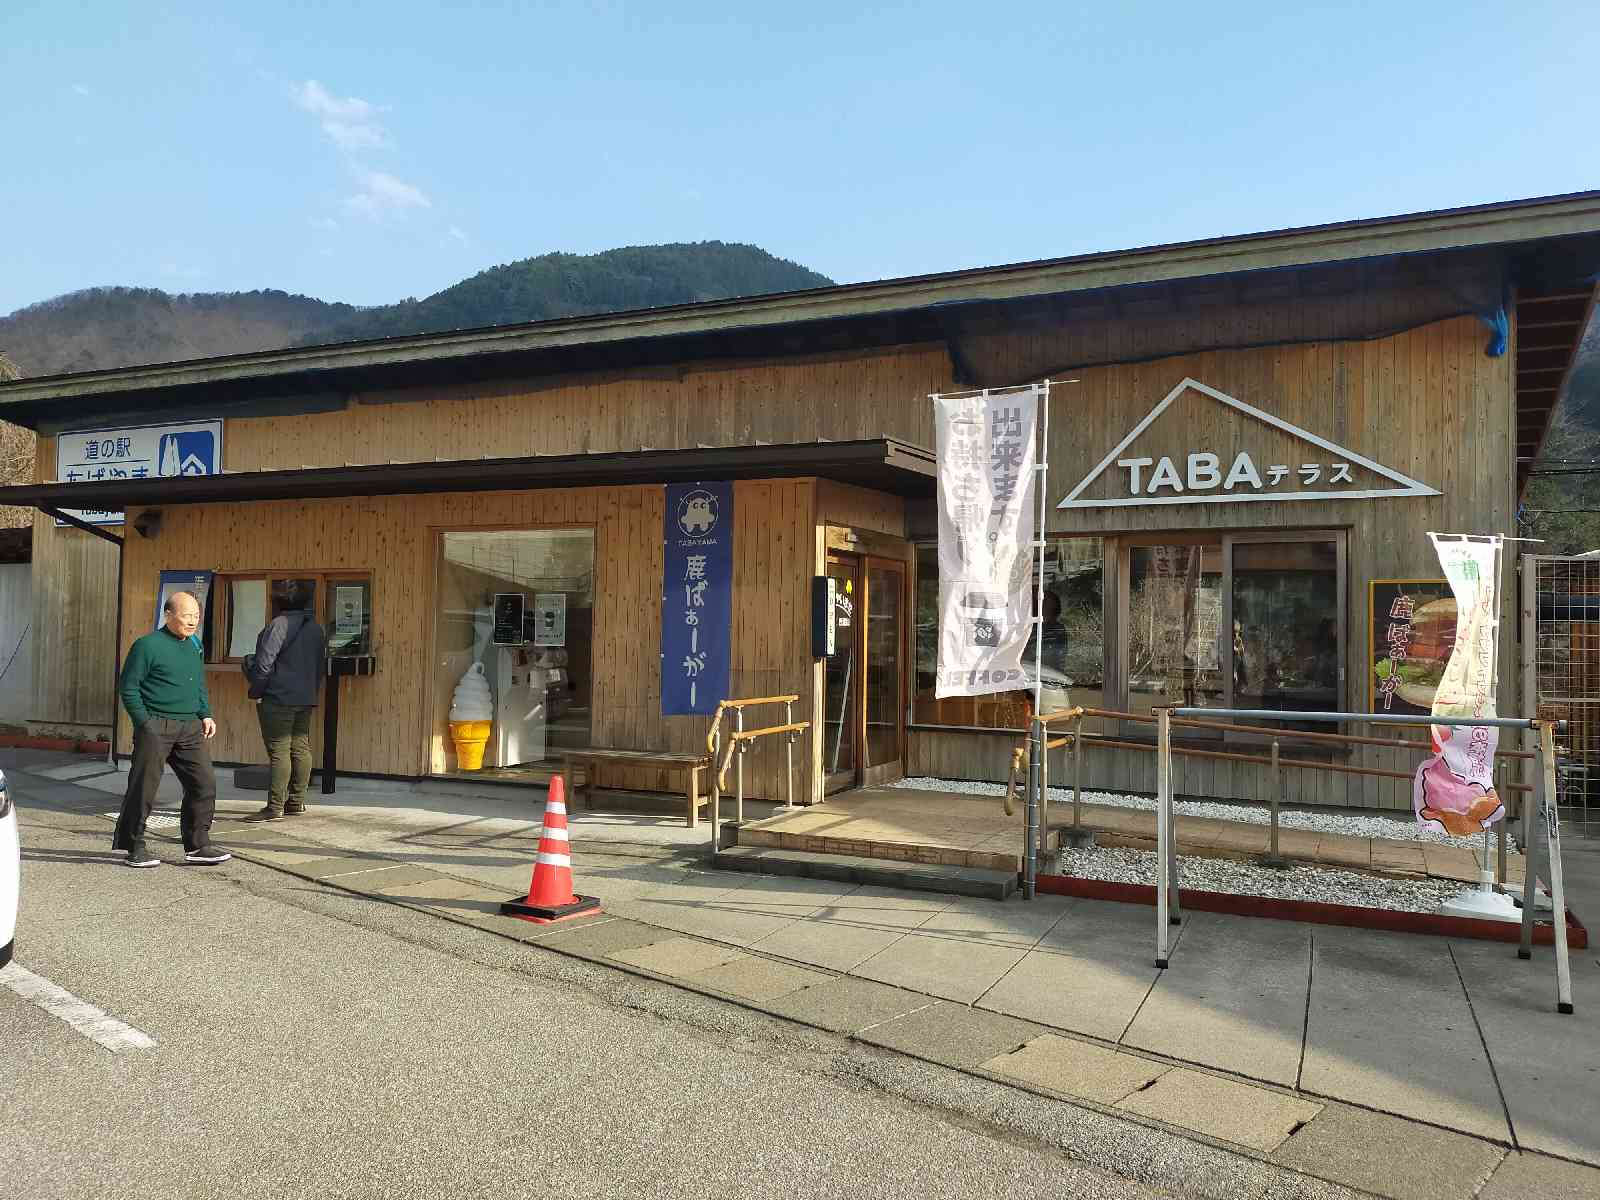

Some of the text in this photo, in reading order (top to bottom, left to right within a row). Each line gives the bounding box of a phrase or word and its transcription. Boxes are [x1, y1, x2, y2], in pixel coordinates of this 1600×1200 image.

[85, 437, 131, 459] 道の駅
[683, 554, 708, 708] 鹿ばぁーがー
